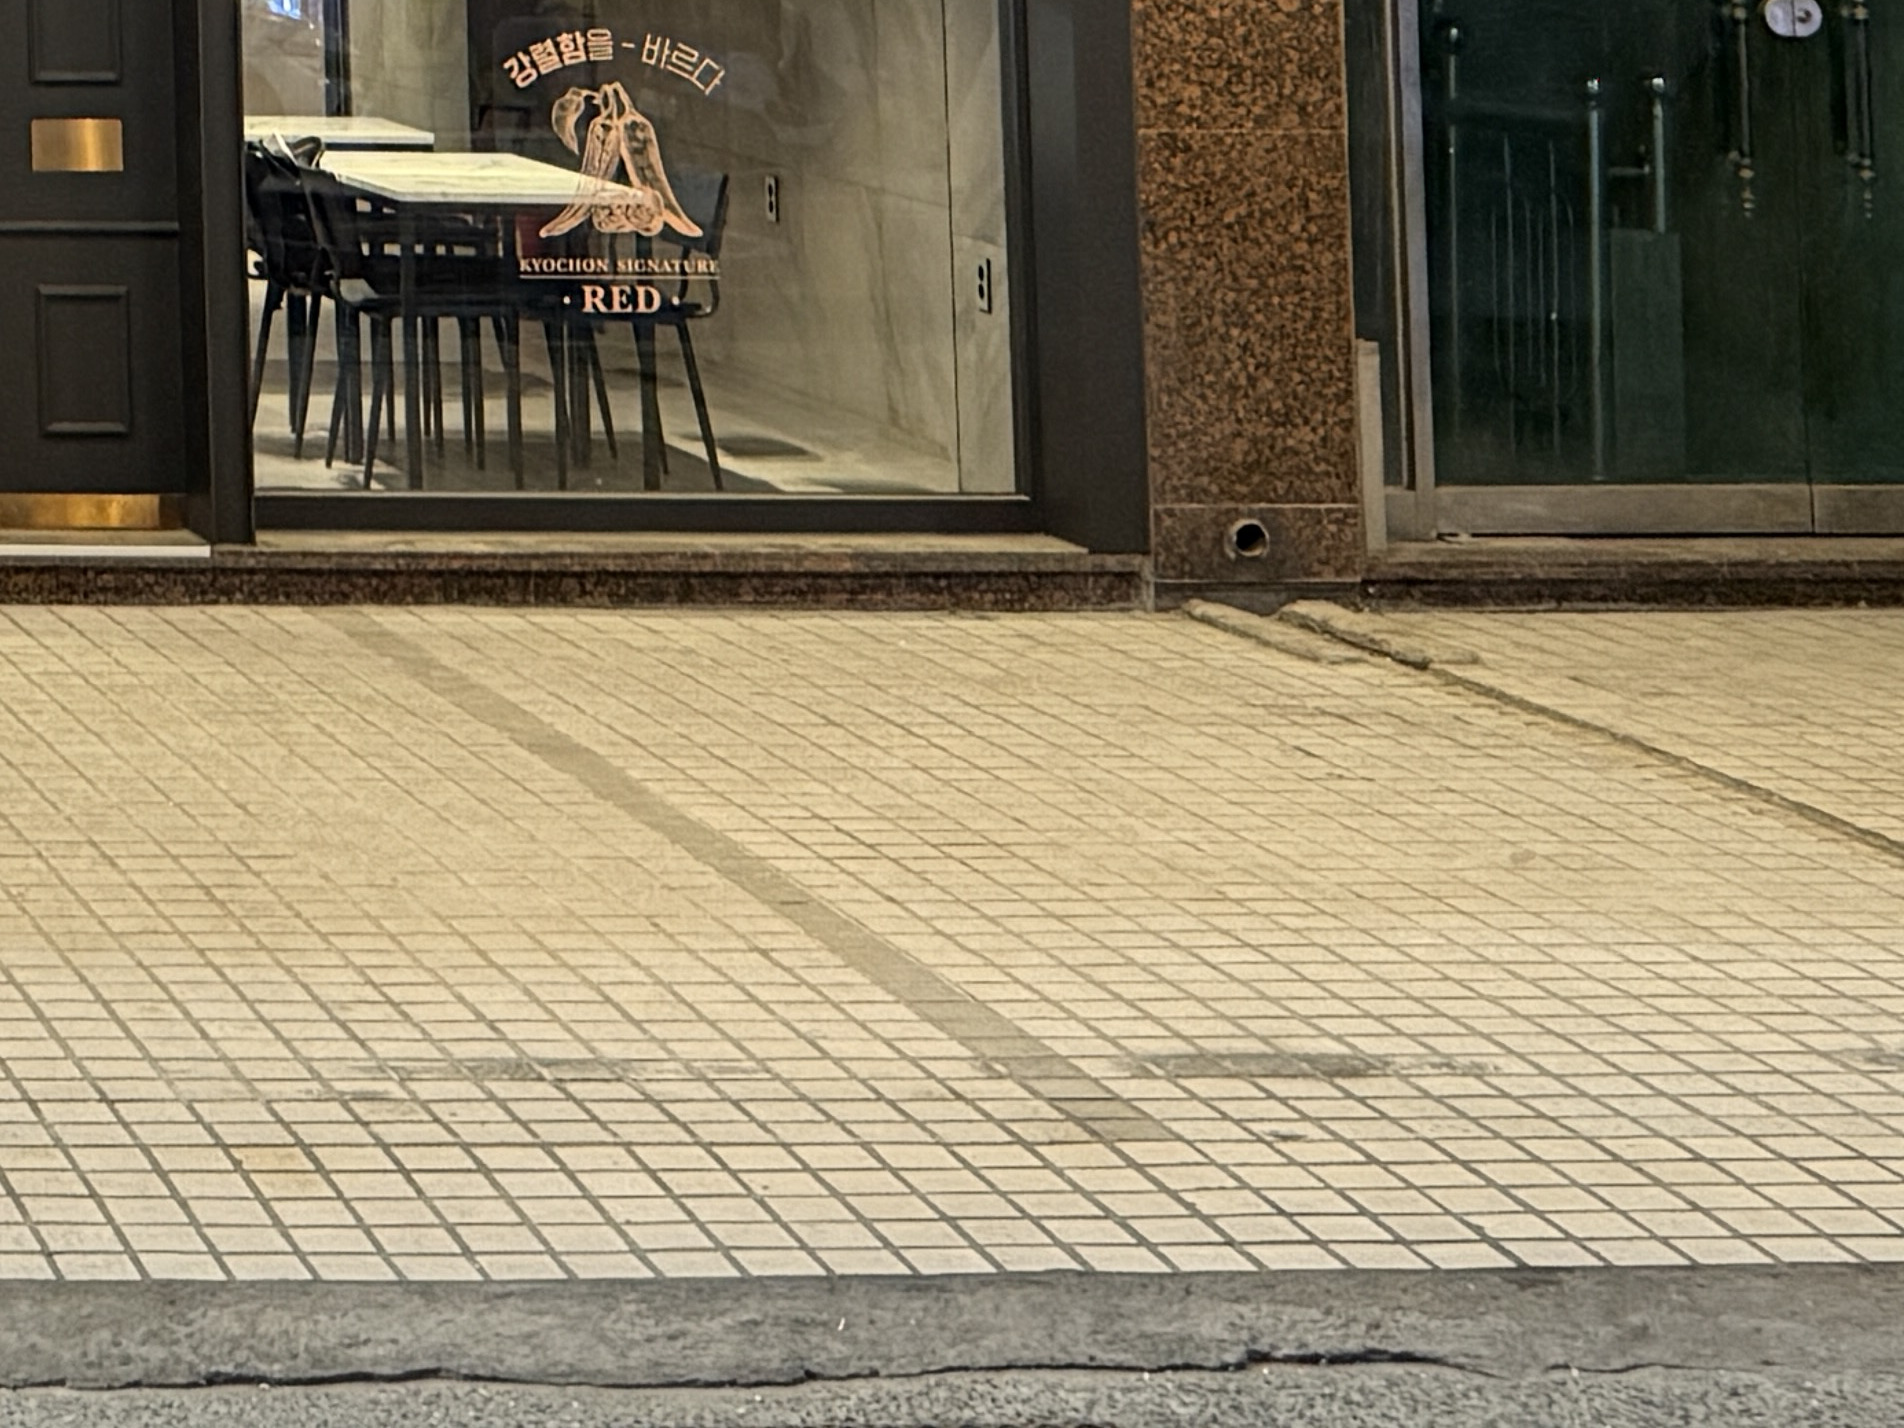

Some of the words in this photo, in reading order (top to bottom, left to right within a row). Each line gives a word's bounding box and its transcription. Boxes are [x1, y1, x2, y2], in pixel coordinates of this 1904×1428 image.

[502, 27, 615, 89] 강렬함을
[641, 32, 727, 96] 바르다
[519, 257, 610, 274] KYOCHON
[616, 257, 721, 274] SIGNATURE
[581, 284, 662, 314] RED
